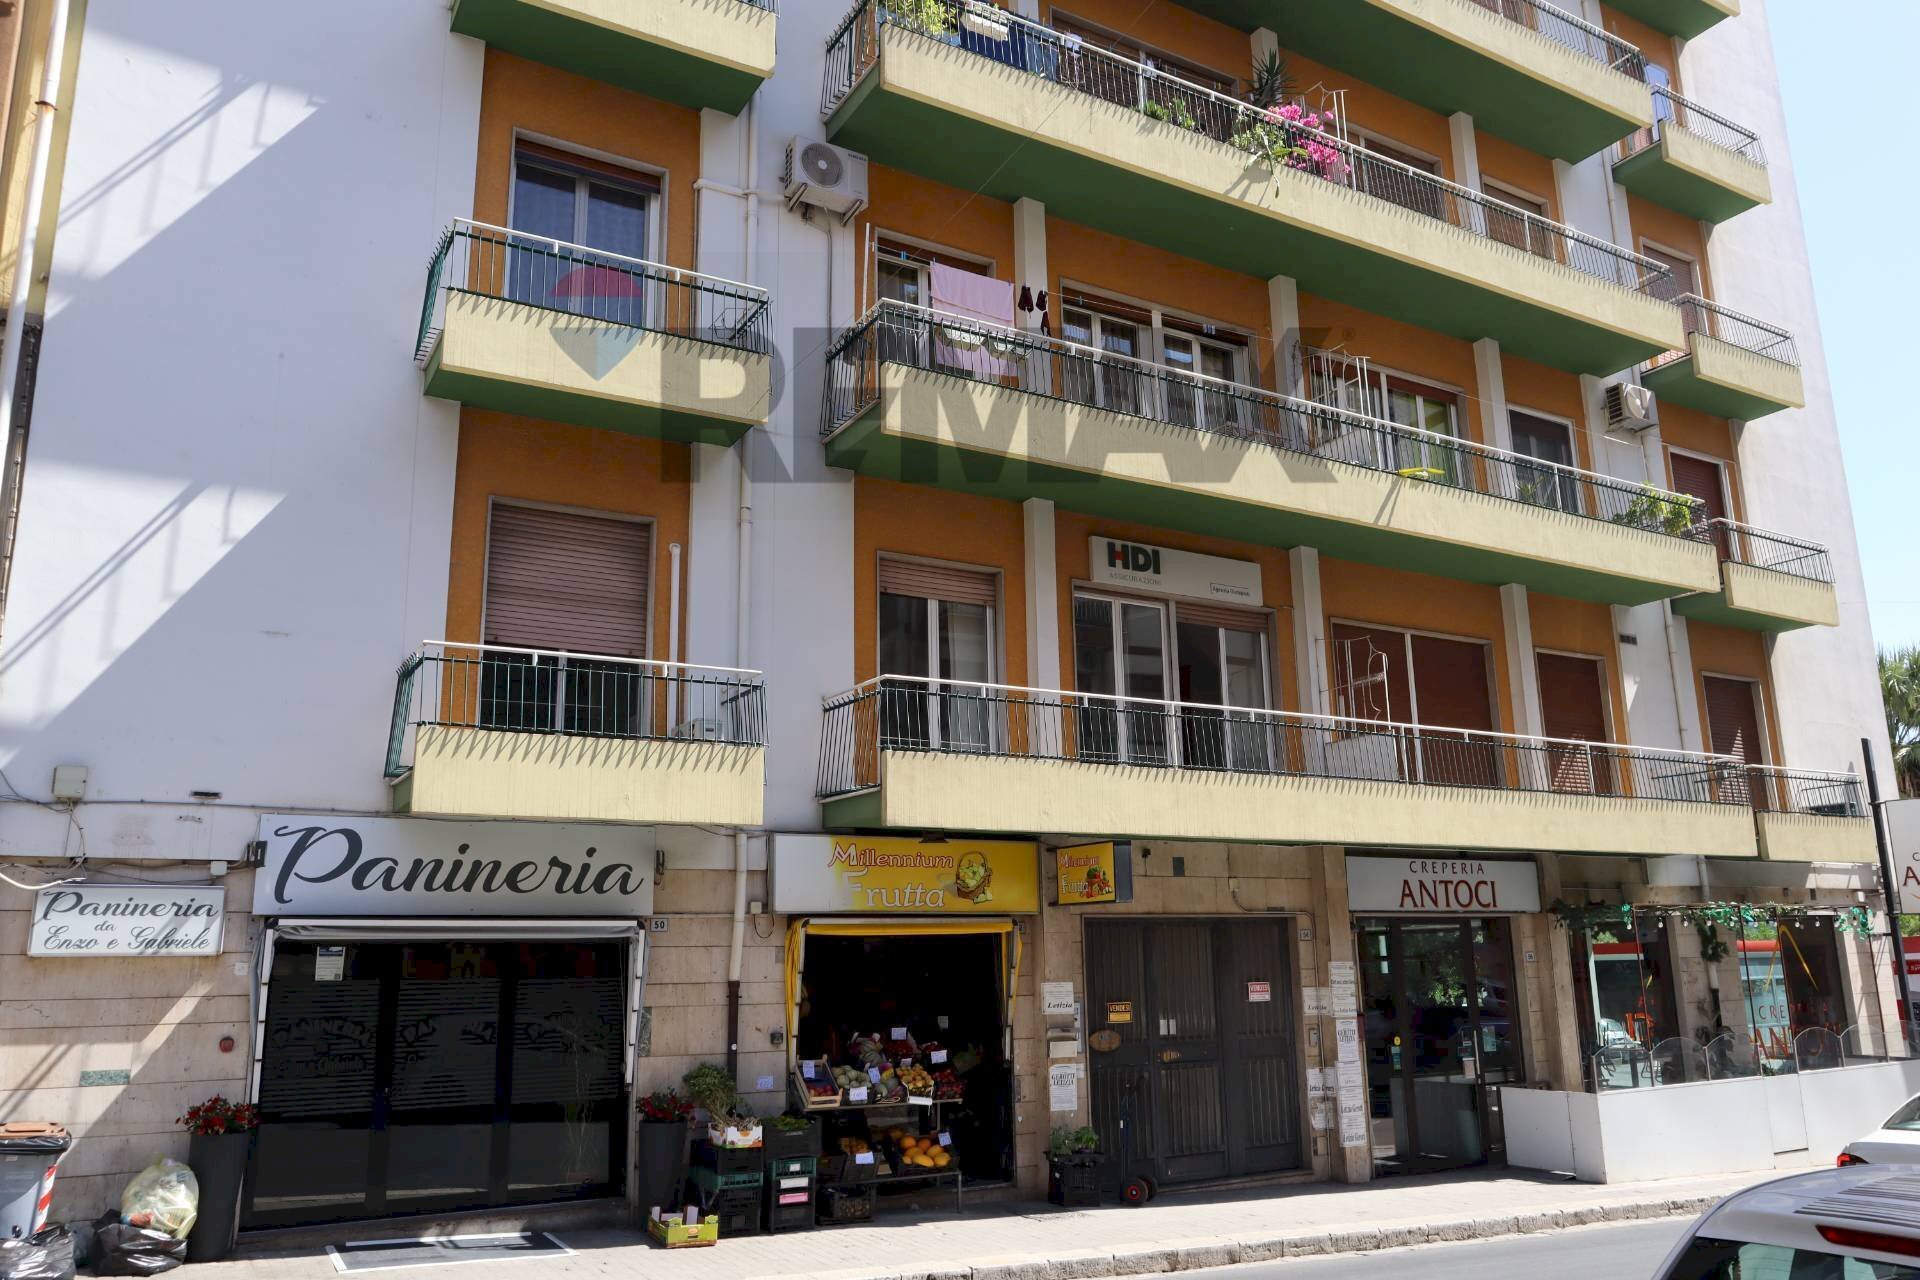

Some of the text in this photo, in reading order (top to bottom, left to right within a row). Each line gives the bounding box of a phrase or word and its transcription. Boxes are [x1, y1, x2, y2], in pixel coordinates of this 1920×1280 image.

[1106, 541, 1162, 575] HDI
[274, 826, 644, 904] Panineria
[827, 841, 954, 869] Millennium
[1409, 860, 1486, 875] CREPERIA
[842, 867, 946, 908] Frutta
[1399, 879, 1498, 908] ANTOCI
[43, 891, 219, 921] Panineria
[44, 925, 211, 951] Enzo e Gabriele
[94, 920, 117, 932] da
[654, 920, 665, 929] 50
